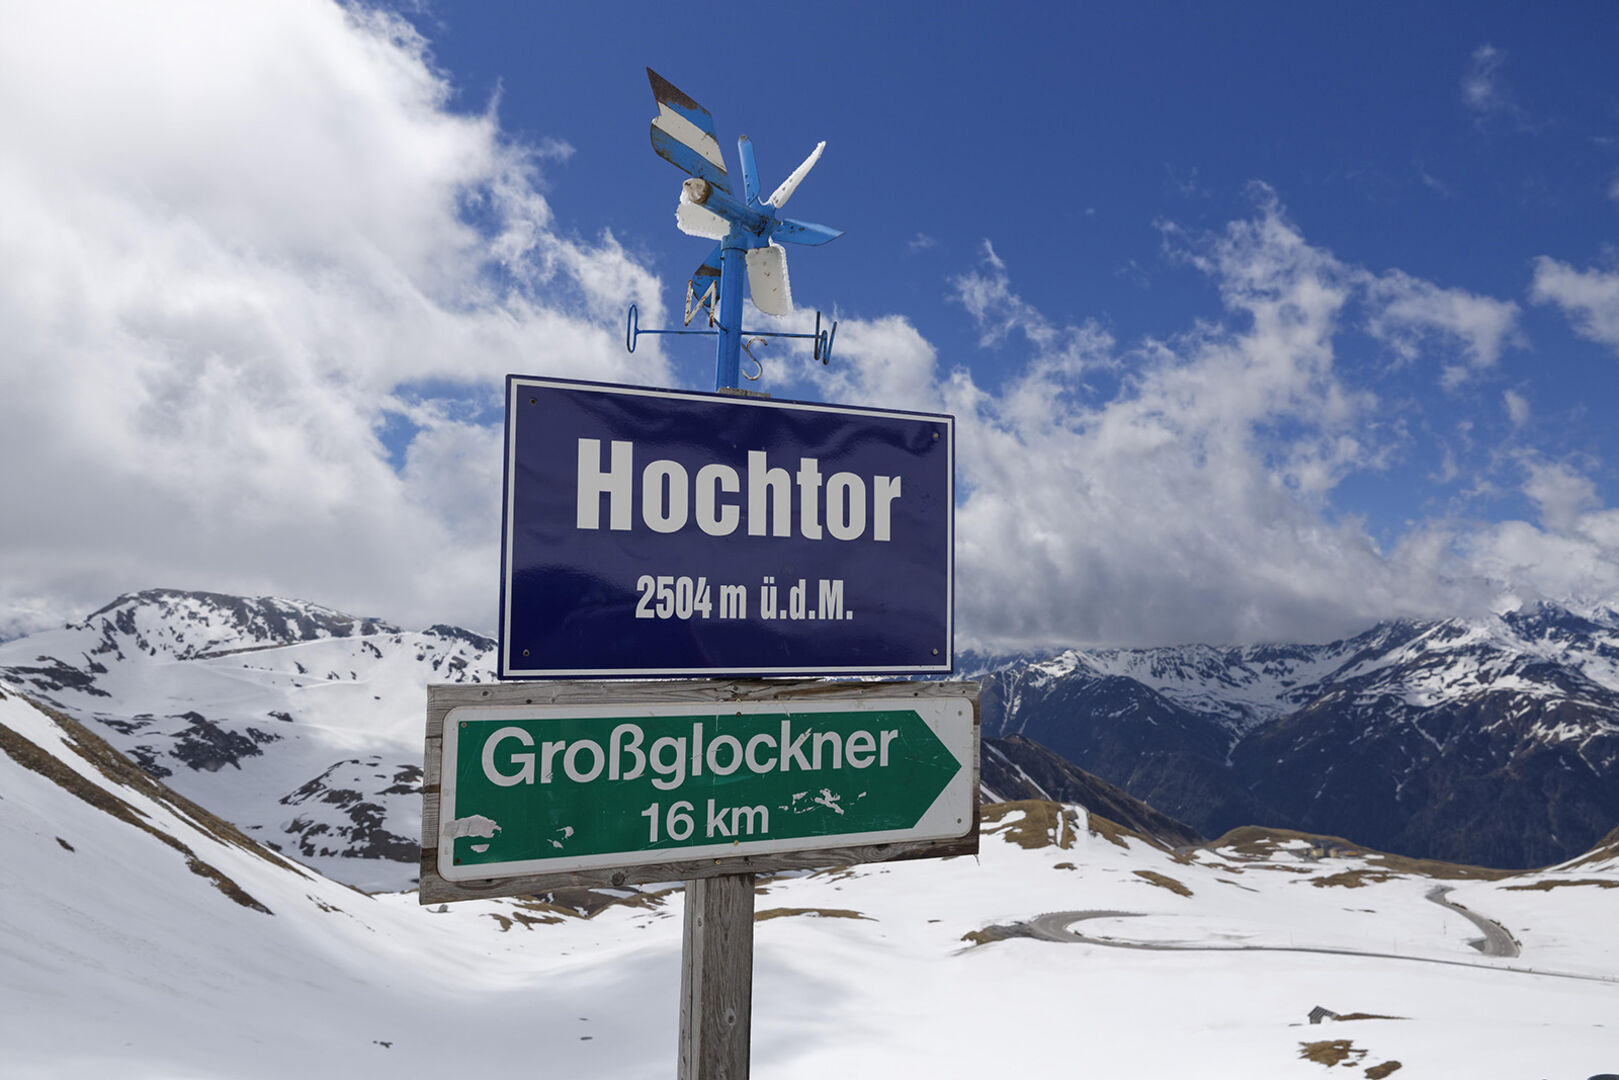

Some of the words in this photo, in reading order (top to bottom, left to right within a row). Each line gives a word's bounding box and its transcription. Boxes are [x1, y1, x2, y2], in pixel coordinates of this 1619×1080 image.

[576, 437, 902, 542] Hochtor
[635, 574, 713, 620] 2504
[719, 584, 747, 619] m
[760, 576, 854, 621] ü.d.M.
[481, 720, 898, 791] Großglockner
[641, 800, 694, 843] 16
[706, 798, 769, 838] km
